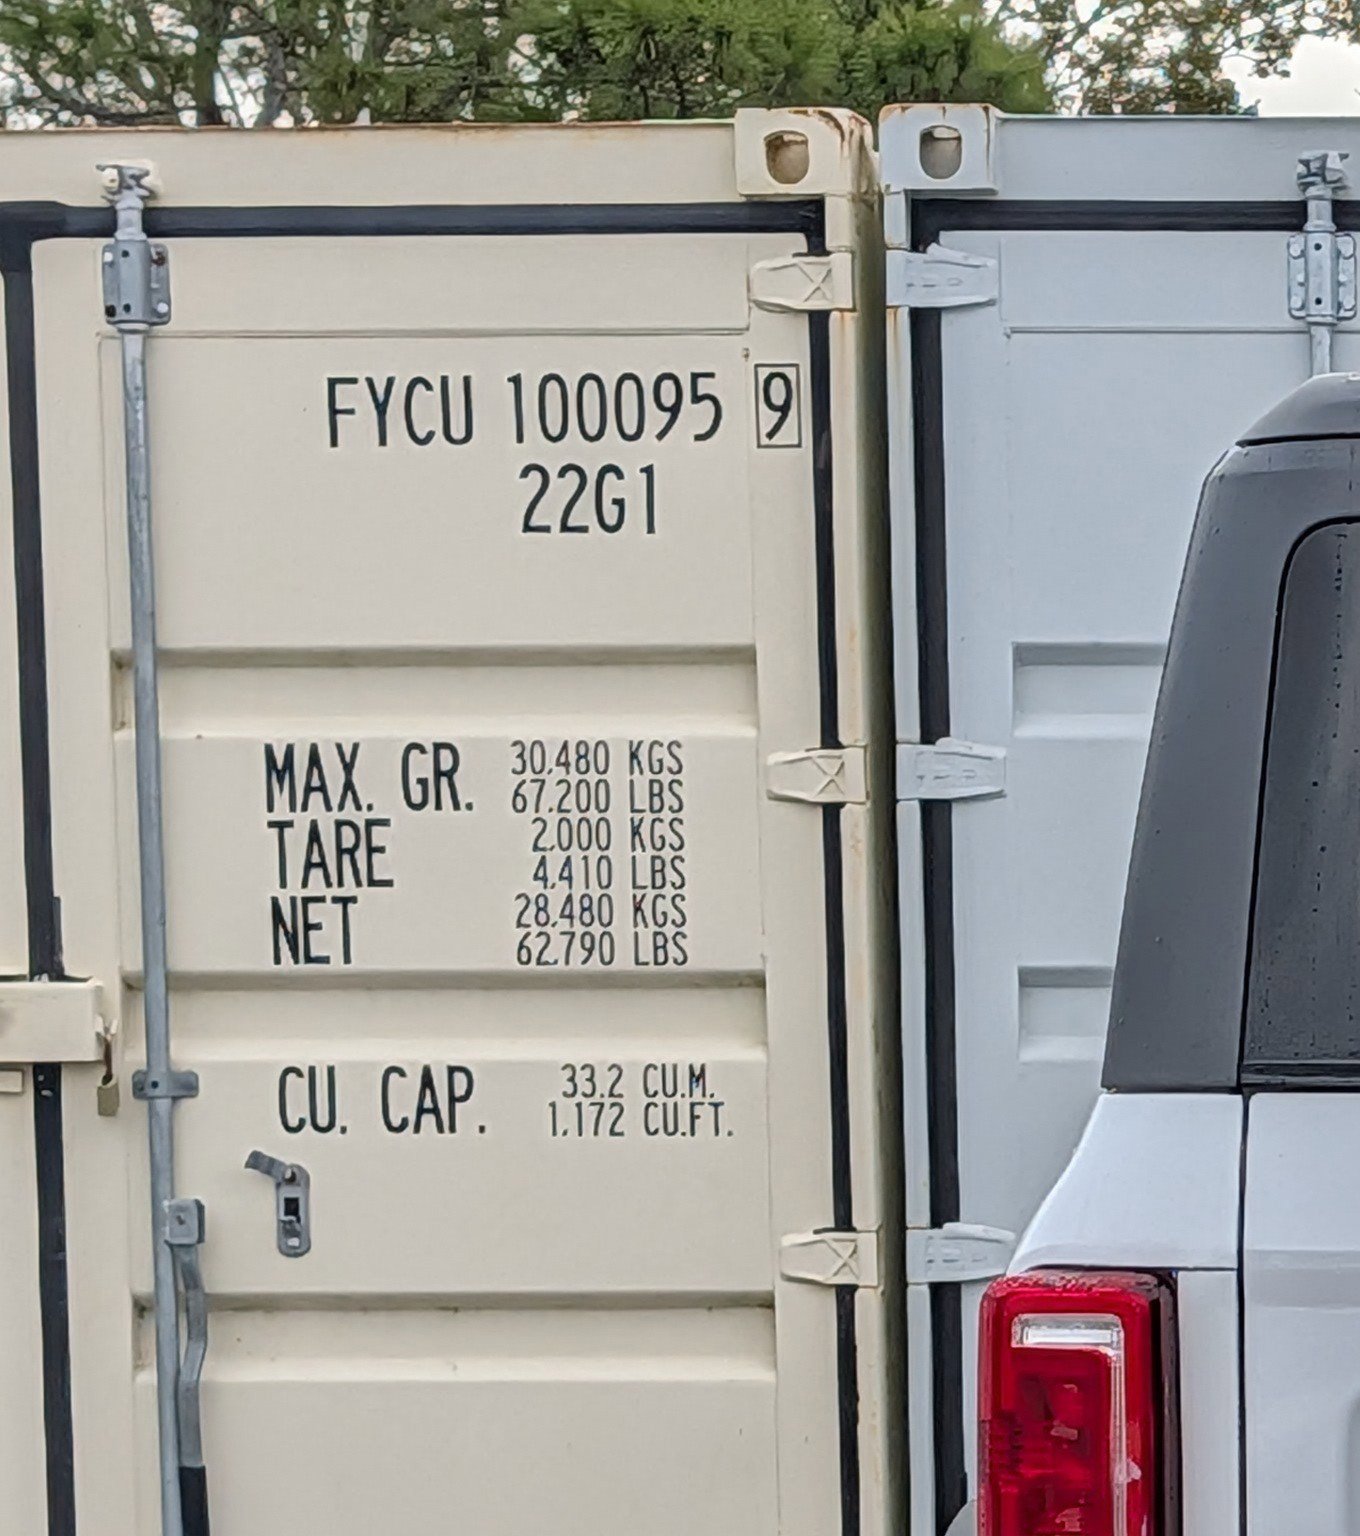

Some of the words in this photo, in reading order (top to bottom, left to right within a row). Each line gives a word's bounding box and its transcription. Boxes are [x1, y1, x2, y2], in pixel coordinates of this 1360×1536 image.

[326, 374, 474, 448] FYCU
[506, 371, 723, 444] 100095
[762, 371, 793, 441] 9
[519, 462, 656, 535] 22G1
[628, 739, 684, 776] KGS
[264, 742, 374, 814] MAX.
[401, 741, 474, 812] GR.
[629, 778, 684, 815] LBS
[629, 816, 685, 853] KGS
[266, 818, 394, 890] TARE
[631, 854, 686, 891] LBS
[632, 892, 687, 929] KGS
[270, 895, 358, 966] NET
[633, 930, 689, 967] LBS
[278, 1065, 348, 1135] CU.
[381, 1064, 486, 1135] CAP.
[561, 1063, 624, 1099] 33.2
[642, 1063, 715, 1099] CU.M.
[643, 1101, 734, 1138] CU.FT.
